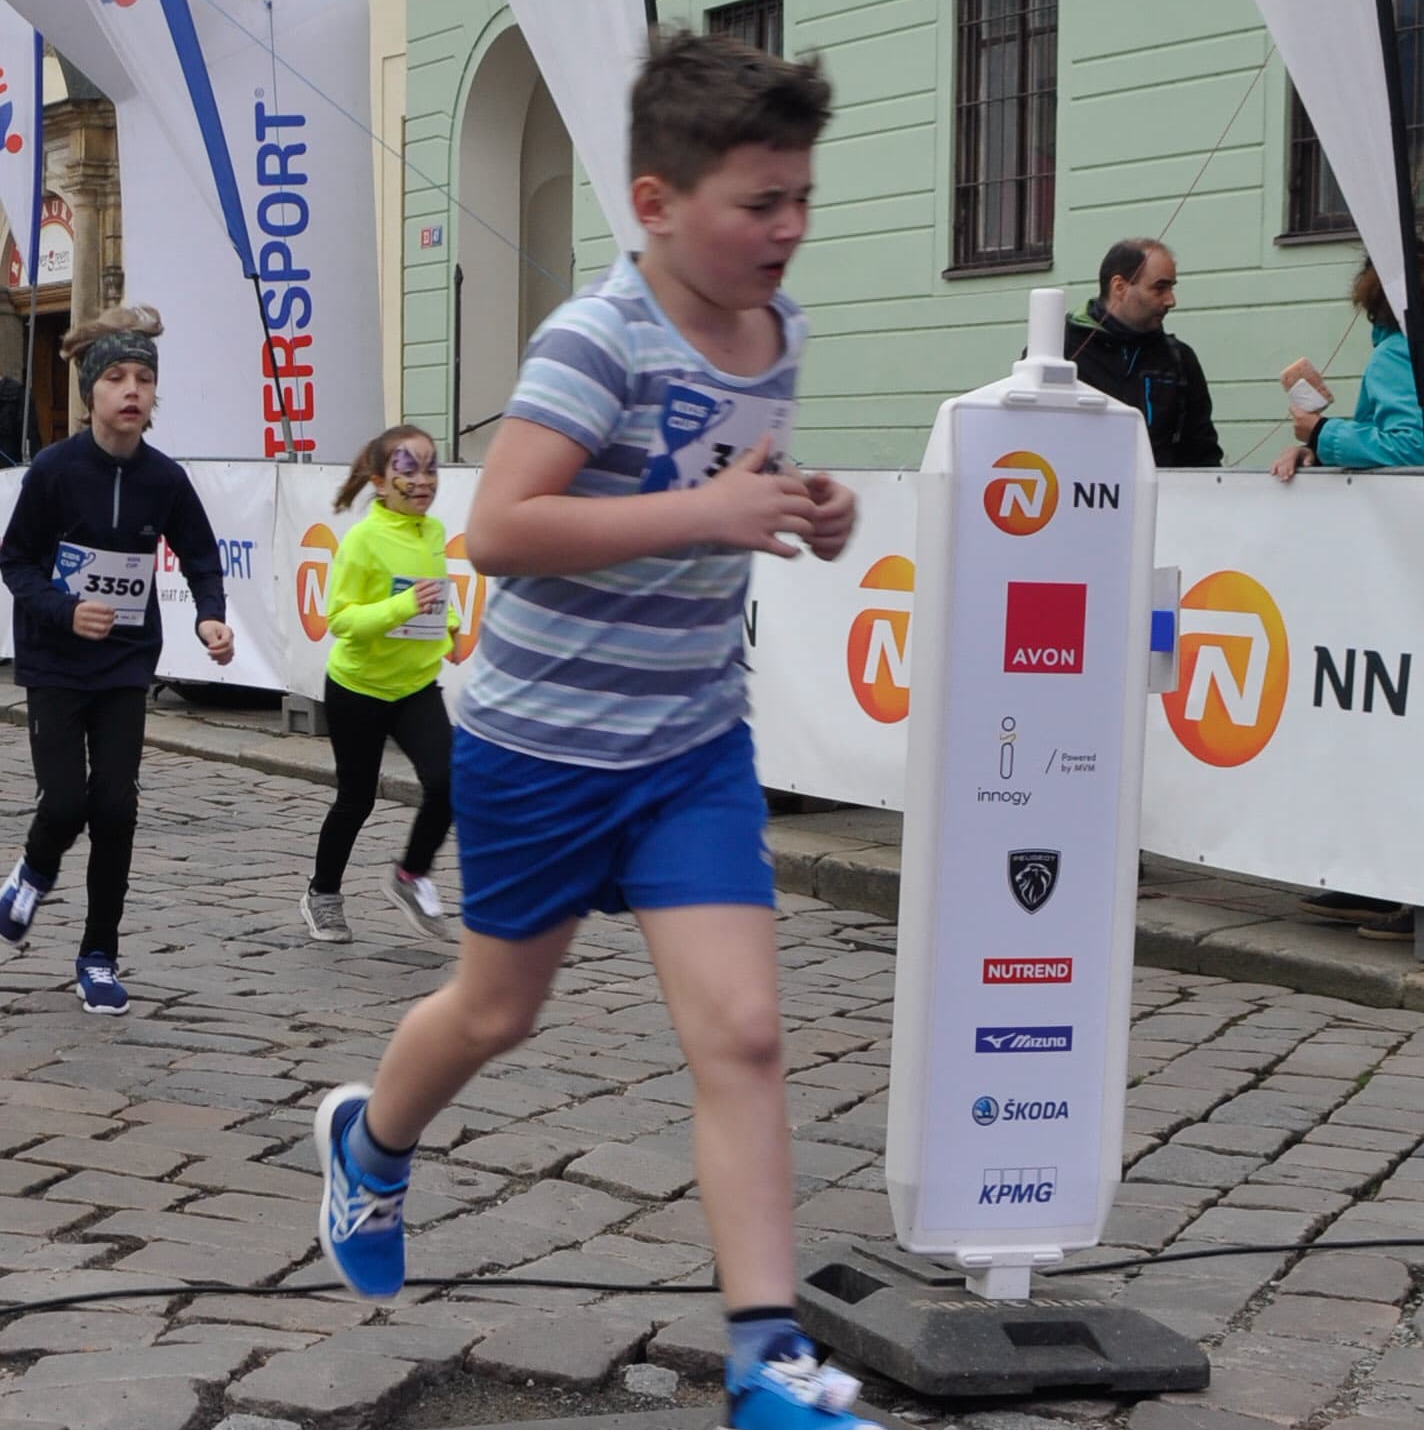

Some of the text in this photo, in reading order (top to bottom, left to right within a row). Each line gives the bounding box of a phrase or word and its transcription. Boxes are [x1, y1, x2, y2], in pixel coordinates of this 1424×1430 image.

[1073, 482, 1120, 510] NN
[84, 574, 145, 597] 3350
[1011, 648, 1075, 667] AVON
[1312, 645, 1412, 717] NN
[1061, 752, 1097, 762] Powered
[1061, 764, 1072, 774] by
[977, 786, 1033, 806] innogy
[987, 962, 1070, 979] NUTREND
[1002, 1096, 1070, 1120] ŠKODA
[978, 1182, 1054, 1204] KPMG
